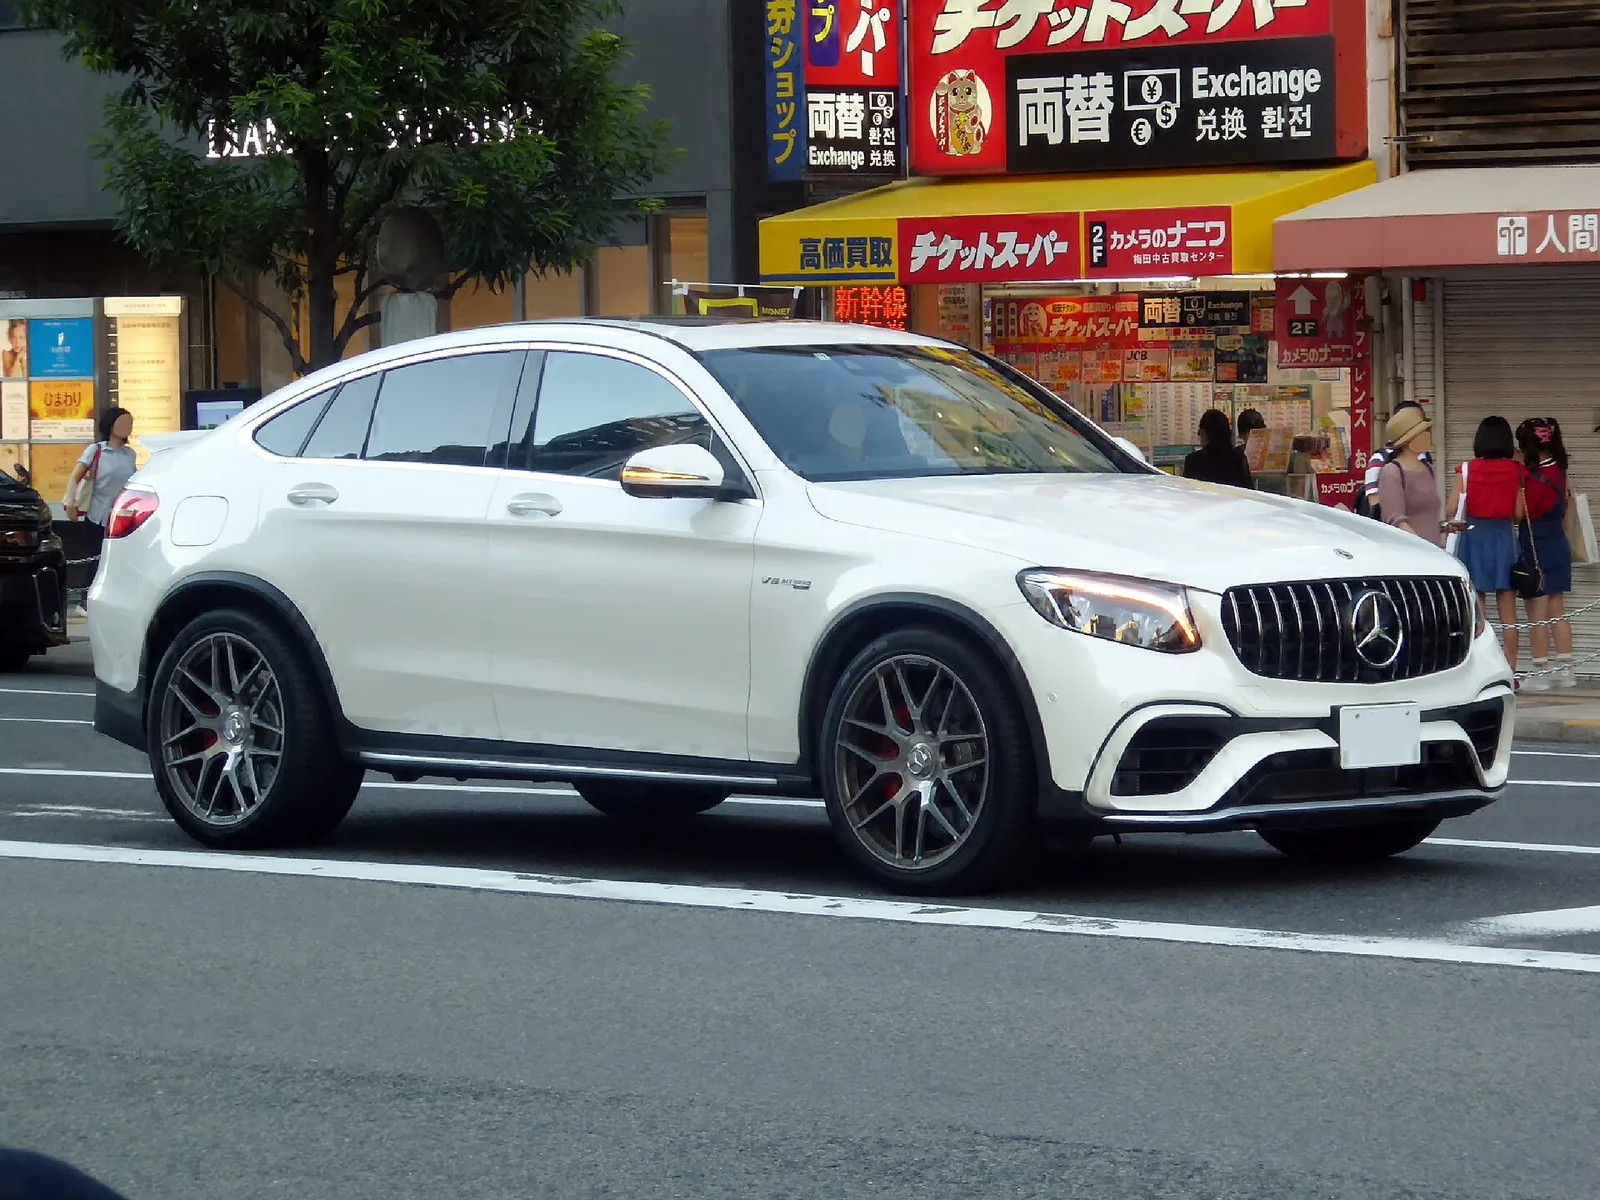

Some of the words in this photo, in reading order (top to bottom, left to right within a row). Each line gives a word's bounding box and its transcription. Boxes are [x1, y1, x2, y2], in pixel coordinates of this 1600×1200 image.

[811, 0, 835, 43] プ
[1192, 66, 1321, 103] Exchange
[806, 93, 865, 139] 両替
[1016, 72, 1114, 147] 両替
[1195, 107, 1247, 142] 兑换
[1260, 103, 1313, 140] 환전
[868, 127, 896, 146] 환전
[808, 146, 865, 169] Exchange
[869, 150, 896, 167] 兑换
[1092, 225, 1104, 263] 2F
[1110, 219, 1226, 251] カメラのナニワ
[1535, 214, 1598, 254] 人間
[799, 236, 893, 270] 高価買取
[909, 230, 1069, 273] チケットスーパー
[1133, 252, 1225, 265] 梅田中古買取センター
[835, 286, 908, 319] 新幹線
[1143, 297, 1182, 324] 両替
[1207, 301, 1244, 311] Exchange
[1048, 316, 1138, 338] チケットスーパー
[1291, 321, 1317, 335] 2F
[1126, 350, 1148, 361] JCB
[1282, 344, 1354, 364] カメラのナニワ
[44, 391, 82, 407] ひまわり
